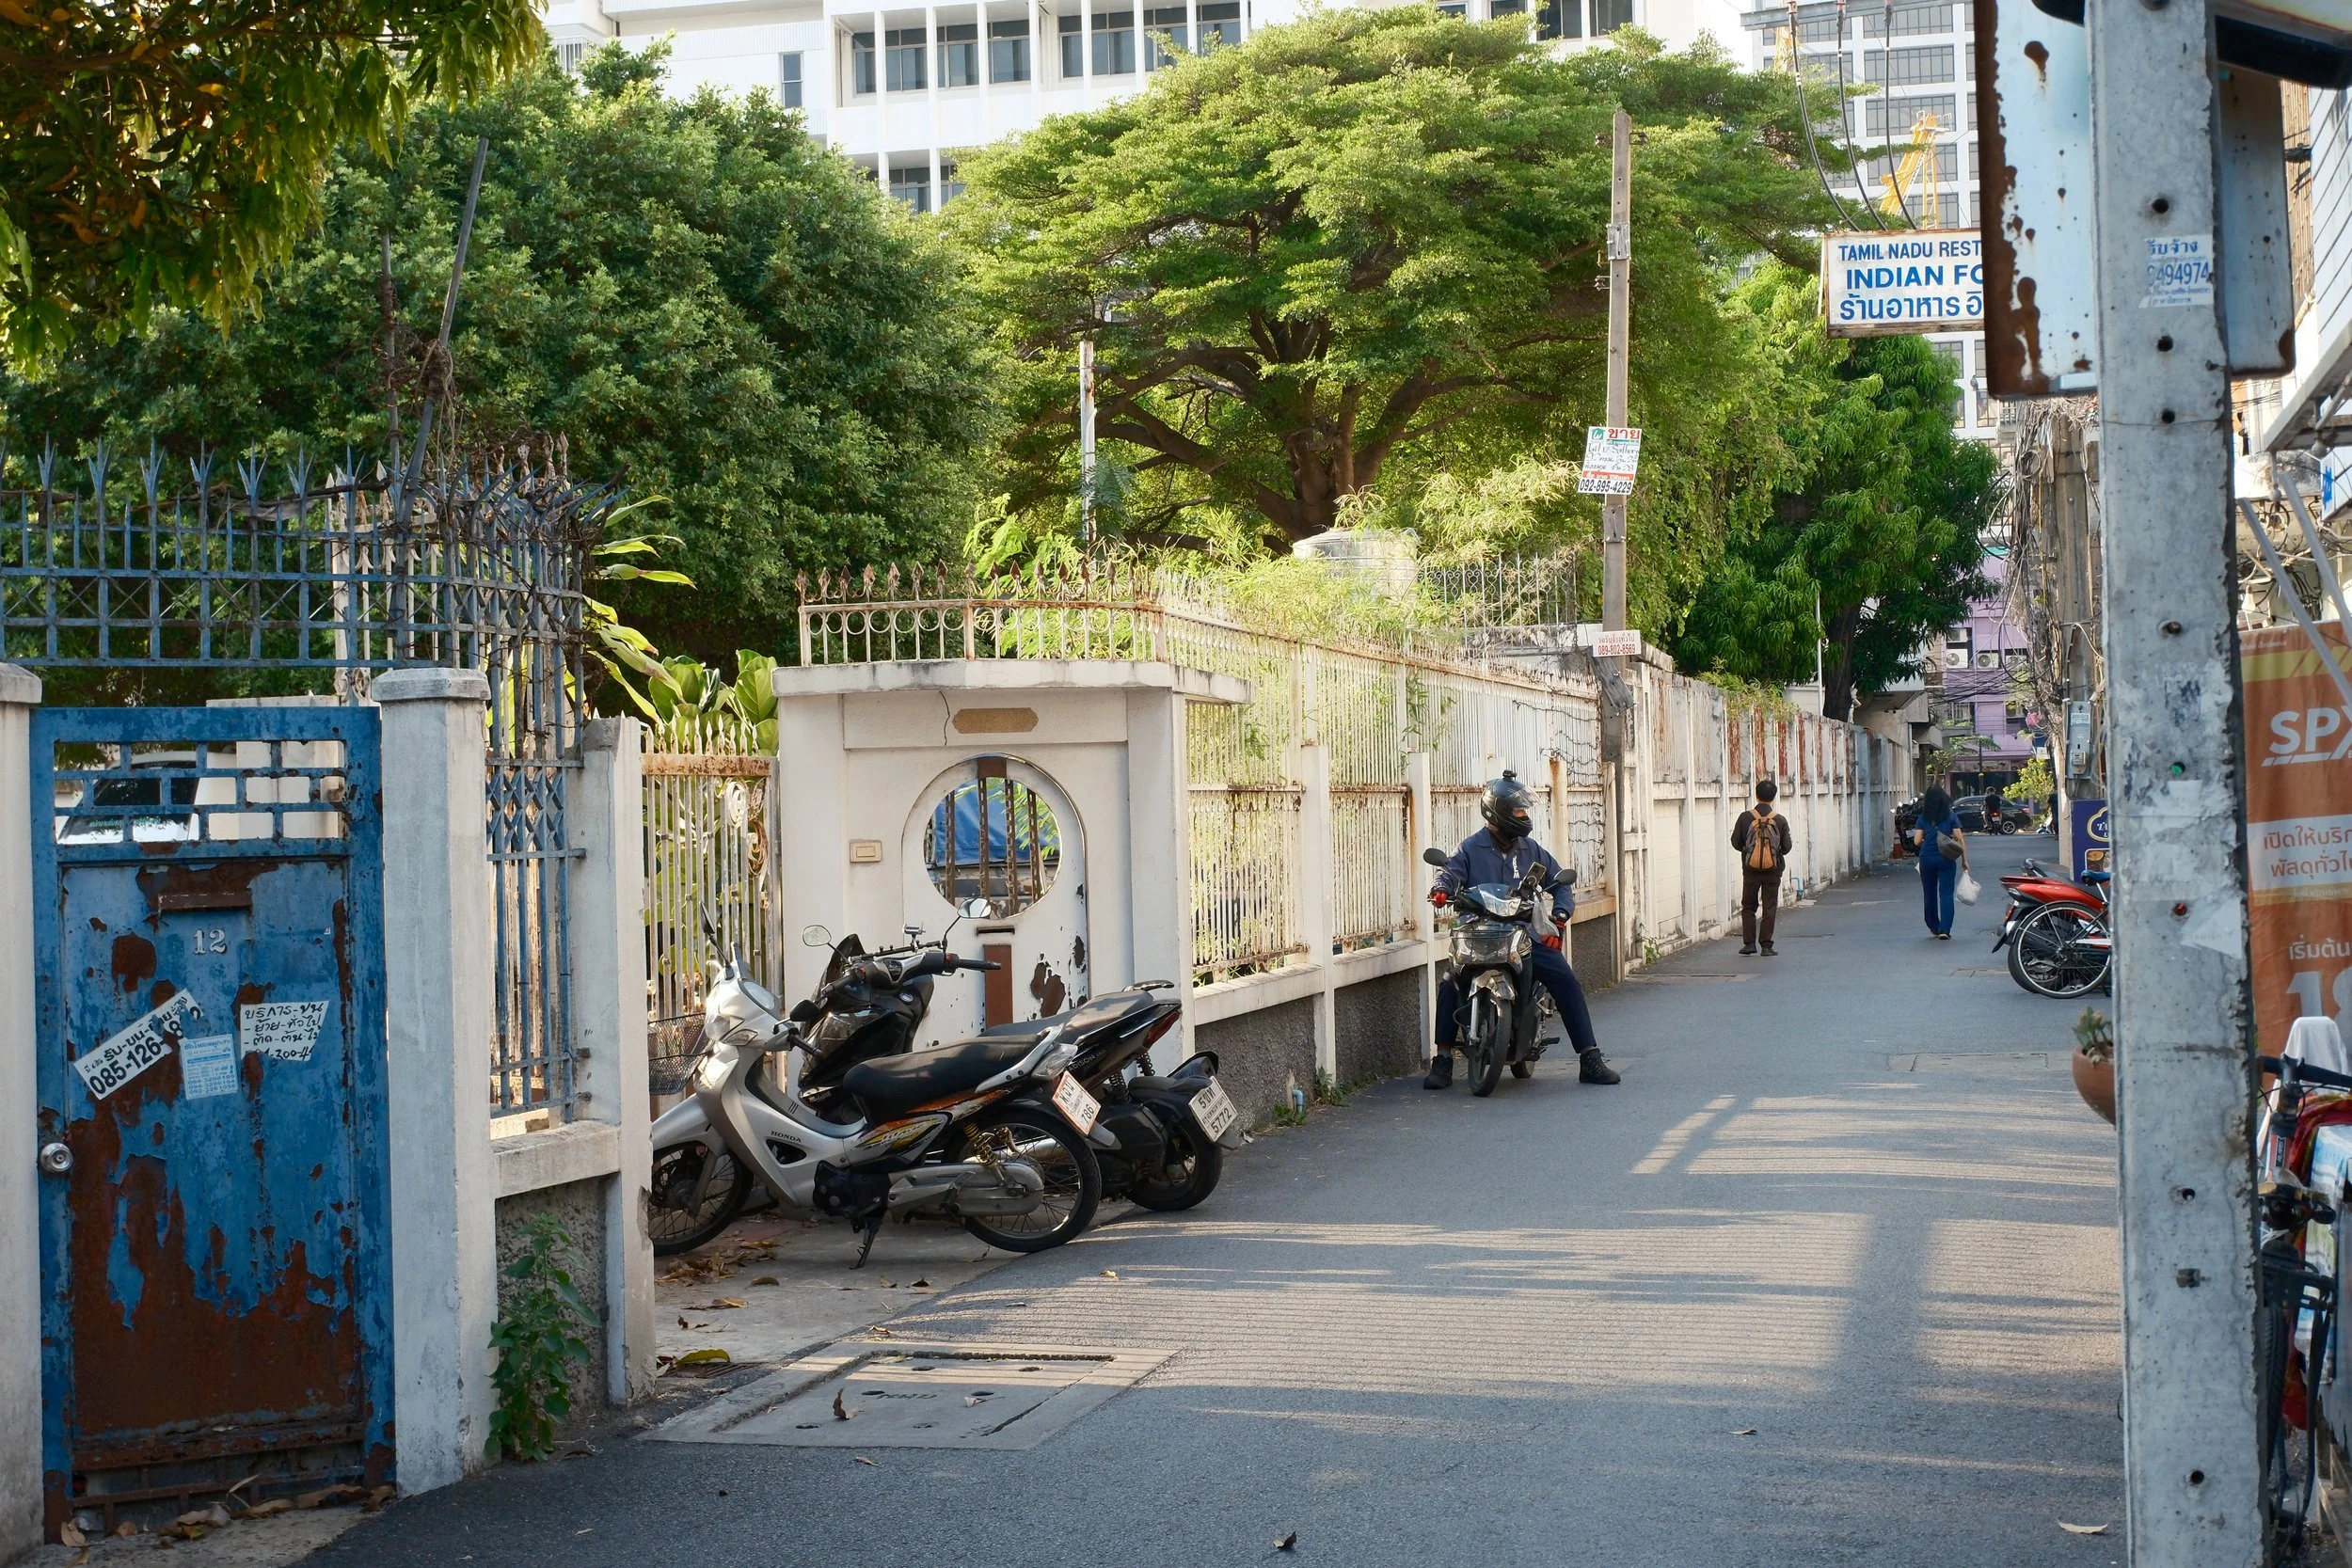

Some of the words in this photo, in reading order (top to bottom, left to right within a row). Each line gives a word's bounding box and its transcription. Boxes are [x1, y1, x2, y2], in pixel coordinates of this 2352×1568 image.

[1838, 245, 1883, 261] TAMIL
[1889, 242, 1933, 260] NADU
[1939, 241, 1982, 257] REST
[1846, 265, 1944, 290] INDIAN
[1840, 293, 1960, 321] ร้านอาหาร
[1608, 428, 1641, 439] ขาย
[1580, 479, 1631, 494] 092-895-4229
[2271, 850, 2352, 879] พัสดุทั่วไ
[194, 928, 227, 955] 12
[1081, 1103, 1095, 1124] 786
[1211, 1107, 1232, 1133] 5772
[771, 1130, 802, 1143] HONDA
